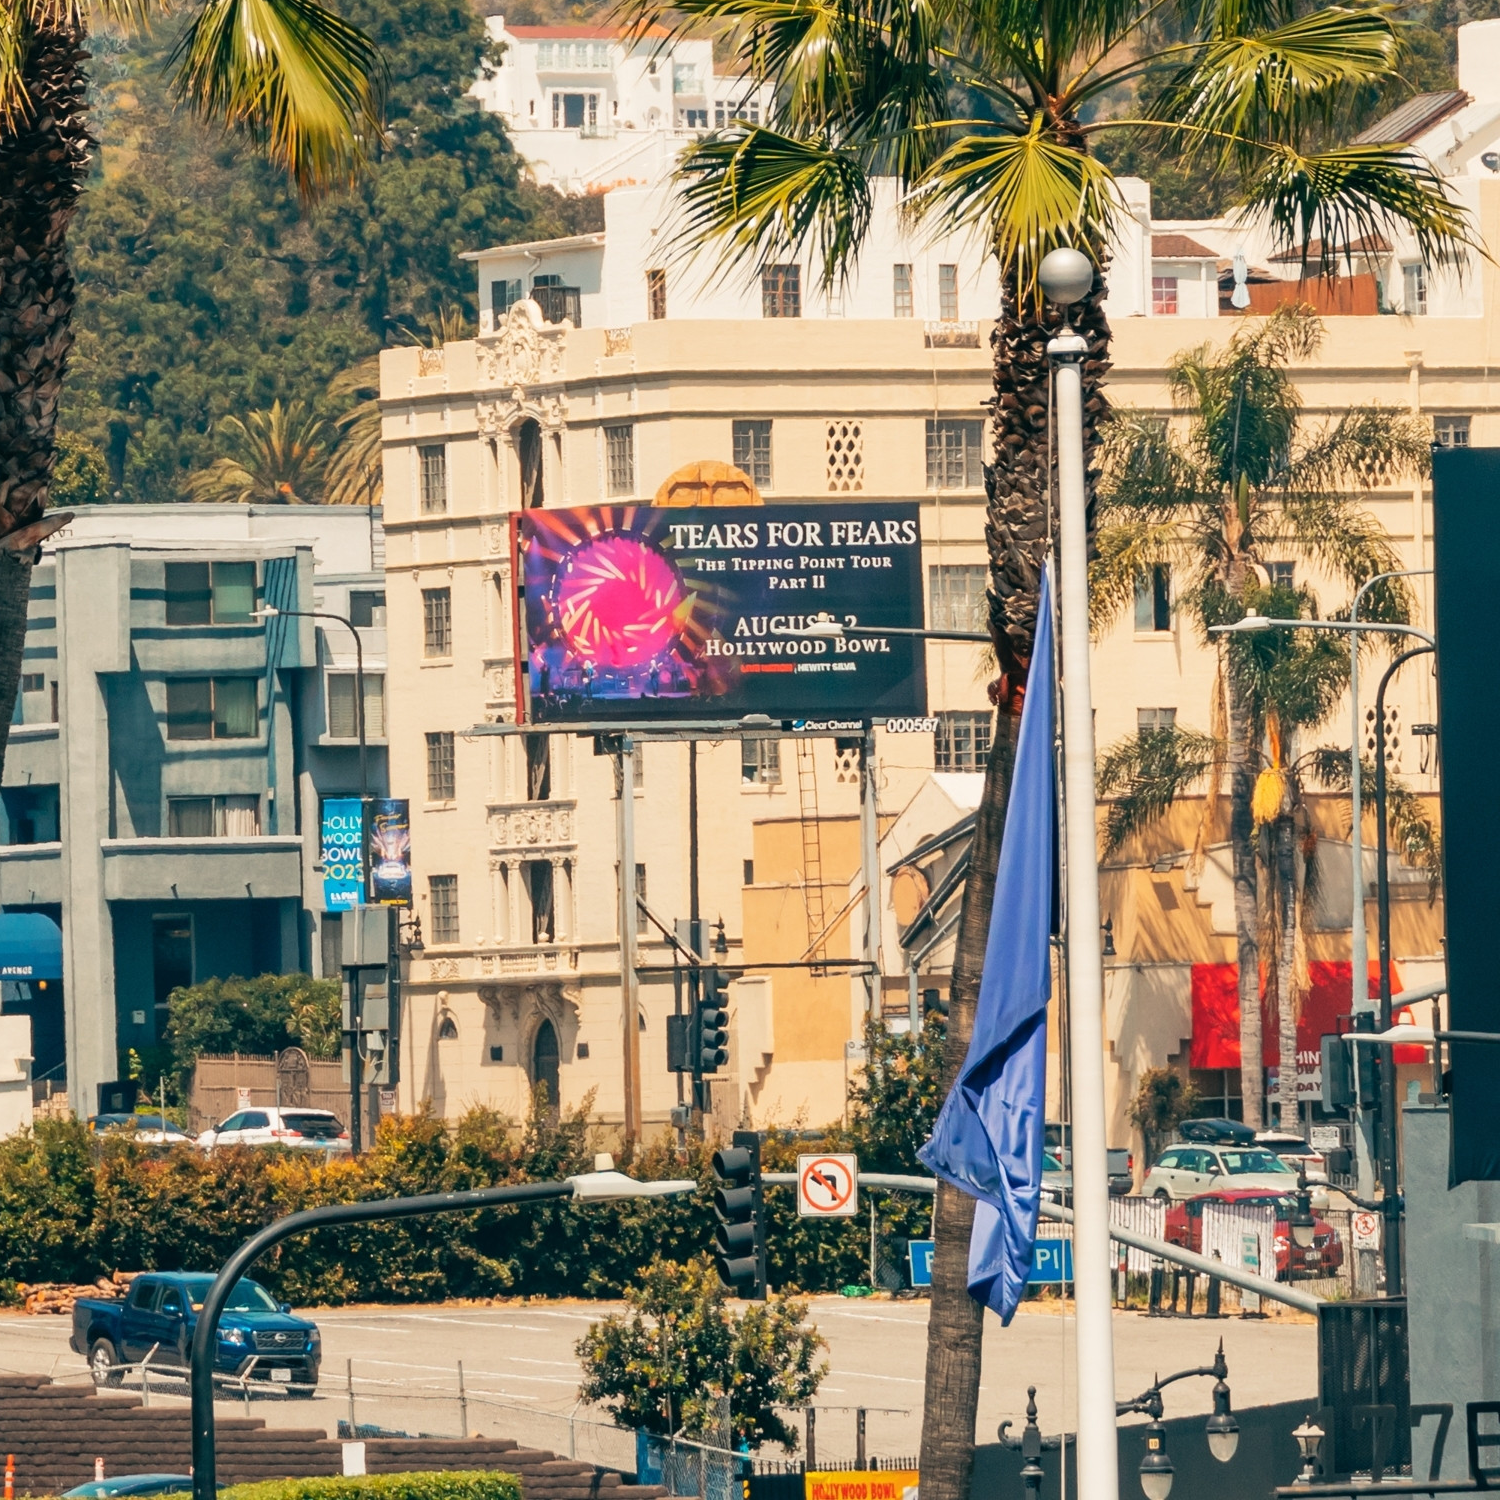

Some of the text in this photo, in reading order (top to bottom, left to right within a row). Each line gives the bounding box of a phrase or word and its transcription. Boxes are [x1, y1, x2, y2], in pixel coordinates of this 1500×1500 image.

[669, 520, 917, 549] TEARS FOR FEARS
[695, 555, 892, 571] THE TIPPING POINT TOUR
[769, 575, 826, 589] PART II
[705, 638, 891, 656] HOLLYWOOD BOWL
[805, 719, 863, 731] Clear Channel
[886, 718, 939, 732] 000567
[811, 1483, 897, 1500] HOLLYWOOD BOWL
